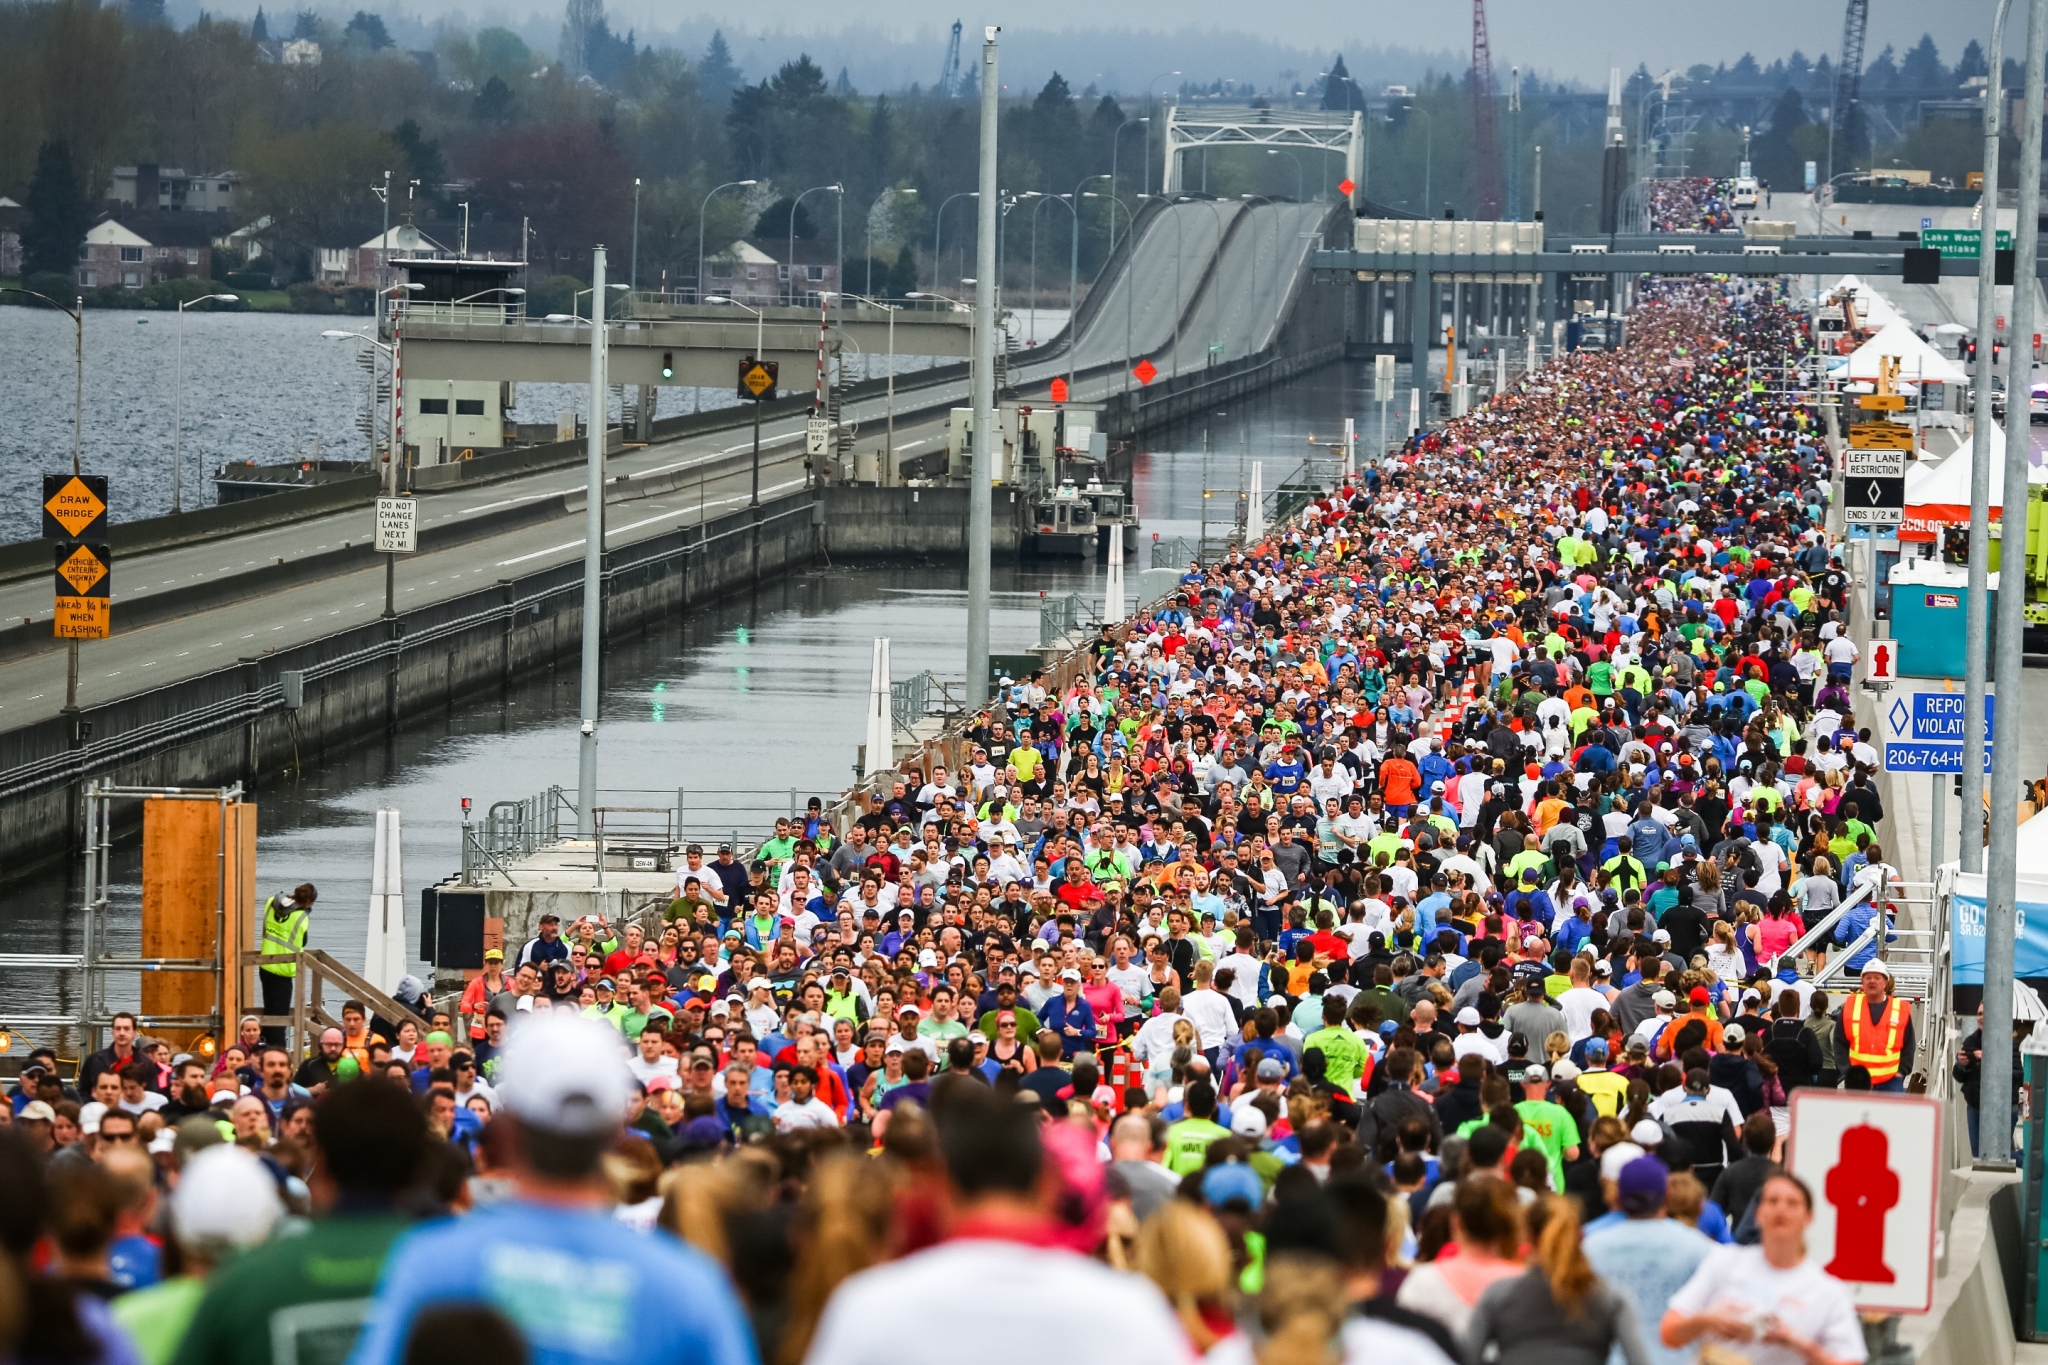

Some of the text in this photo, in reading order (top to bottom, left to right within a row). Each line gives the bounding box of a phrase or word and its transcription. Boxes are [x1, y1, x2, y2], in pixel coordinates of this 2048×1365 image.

[1924, 233, 1949, 242] Lake
[1953, 233, 1980, 242] Wash
[748, 380, 766, 388] BRIDGE
[1849, 454, 1902, 464] LEFT LANE
[1850, 465, 1900, 475] RESTRICTION
[59, 495, 91, 504] DRAW
[381, 501, 412, 510] DO NOT
[56, 509, 94, 518] BRIDGE
[379, 511, 413, 520] CHANGE
[1847, 510, 1868, 520] ENDS
[1872, 510, 1886, 520] 1/2
[382, 520, 410, 529] LANES
[384, 530, 406, 539] NEXT
[382, 539, 394, 548] 1/2
[68, 557, 99, 566] VEHICLES
[67, 566, 99, 575] ENTERING
[68, 574, 97, 582] HIGHWAY
[56, 602, 82, 610] AHEAD
[69, 613, 94, 622] WHEN
[60, 624, 103, 634] FLASHING
[1926, 697, 1965, 714] REPO
[1916, 717, 1989, 735] VIOLATS
[1959, 904, 1980, 924] GO
[1960, 923, 1972, 936] SR
